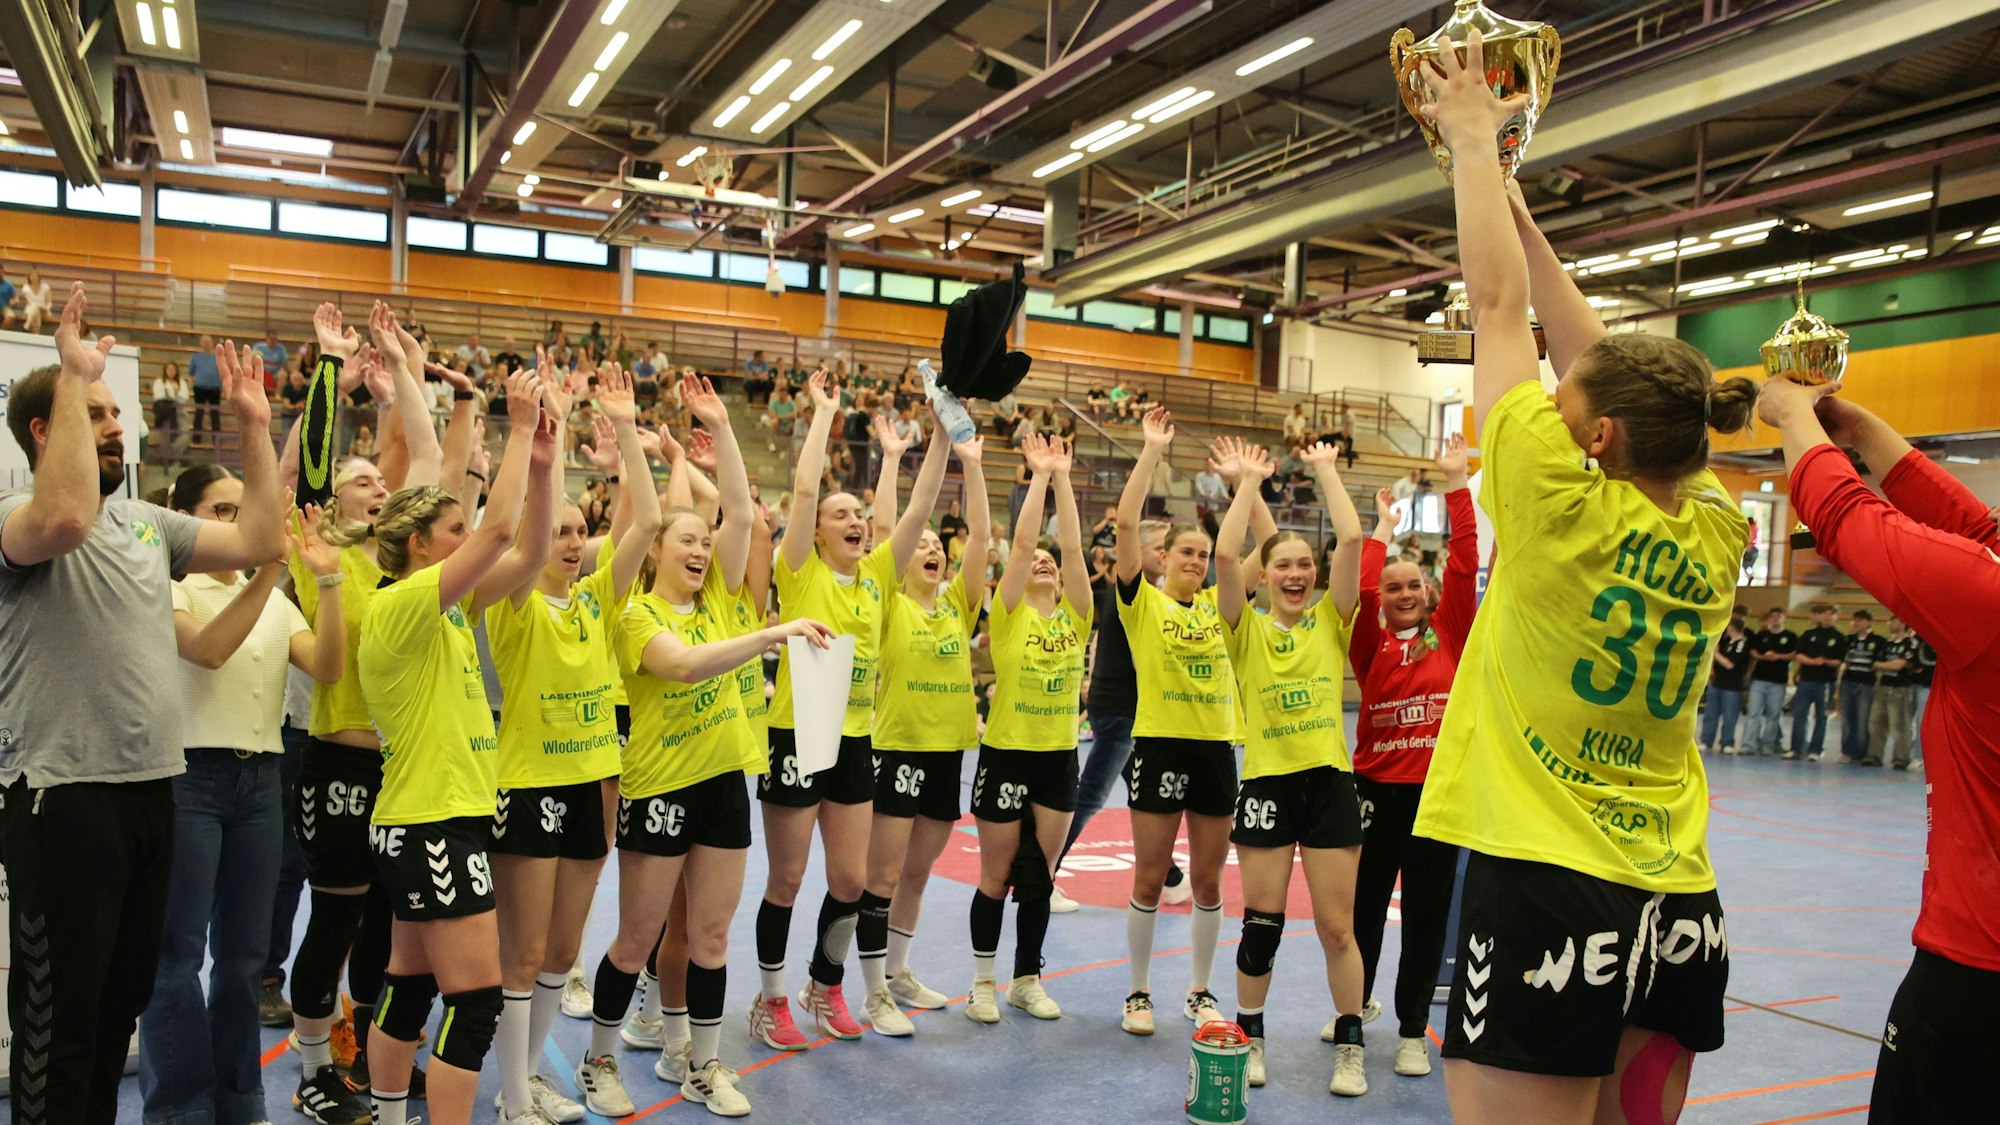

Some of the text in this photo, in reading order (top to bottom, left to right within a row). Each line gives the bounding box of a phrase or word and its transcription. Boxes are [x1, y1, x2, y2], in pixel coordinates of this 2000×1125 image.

[1163, 619, 1222, 640] Plusne
[1571, 585, 1708, 720] 30
[907, 680, 949, 693] Wlodarek
[1163, 690, 1205, 703] Wlodarek
[1409, 735, 1436, 749] Gerüs
[1578, 727, 1645, 770] KUBA
